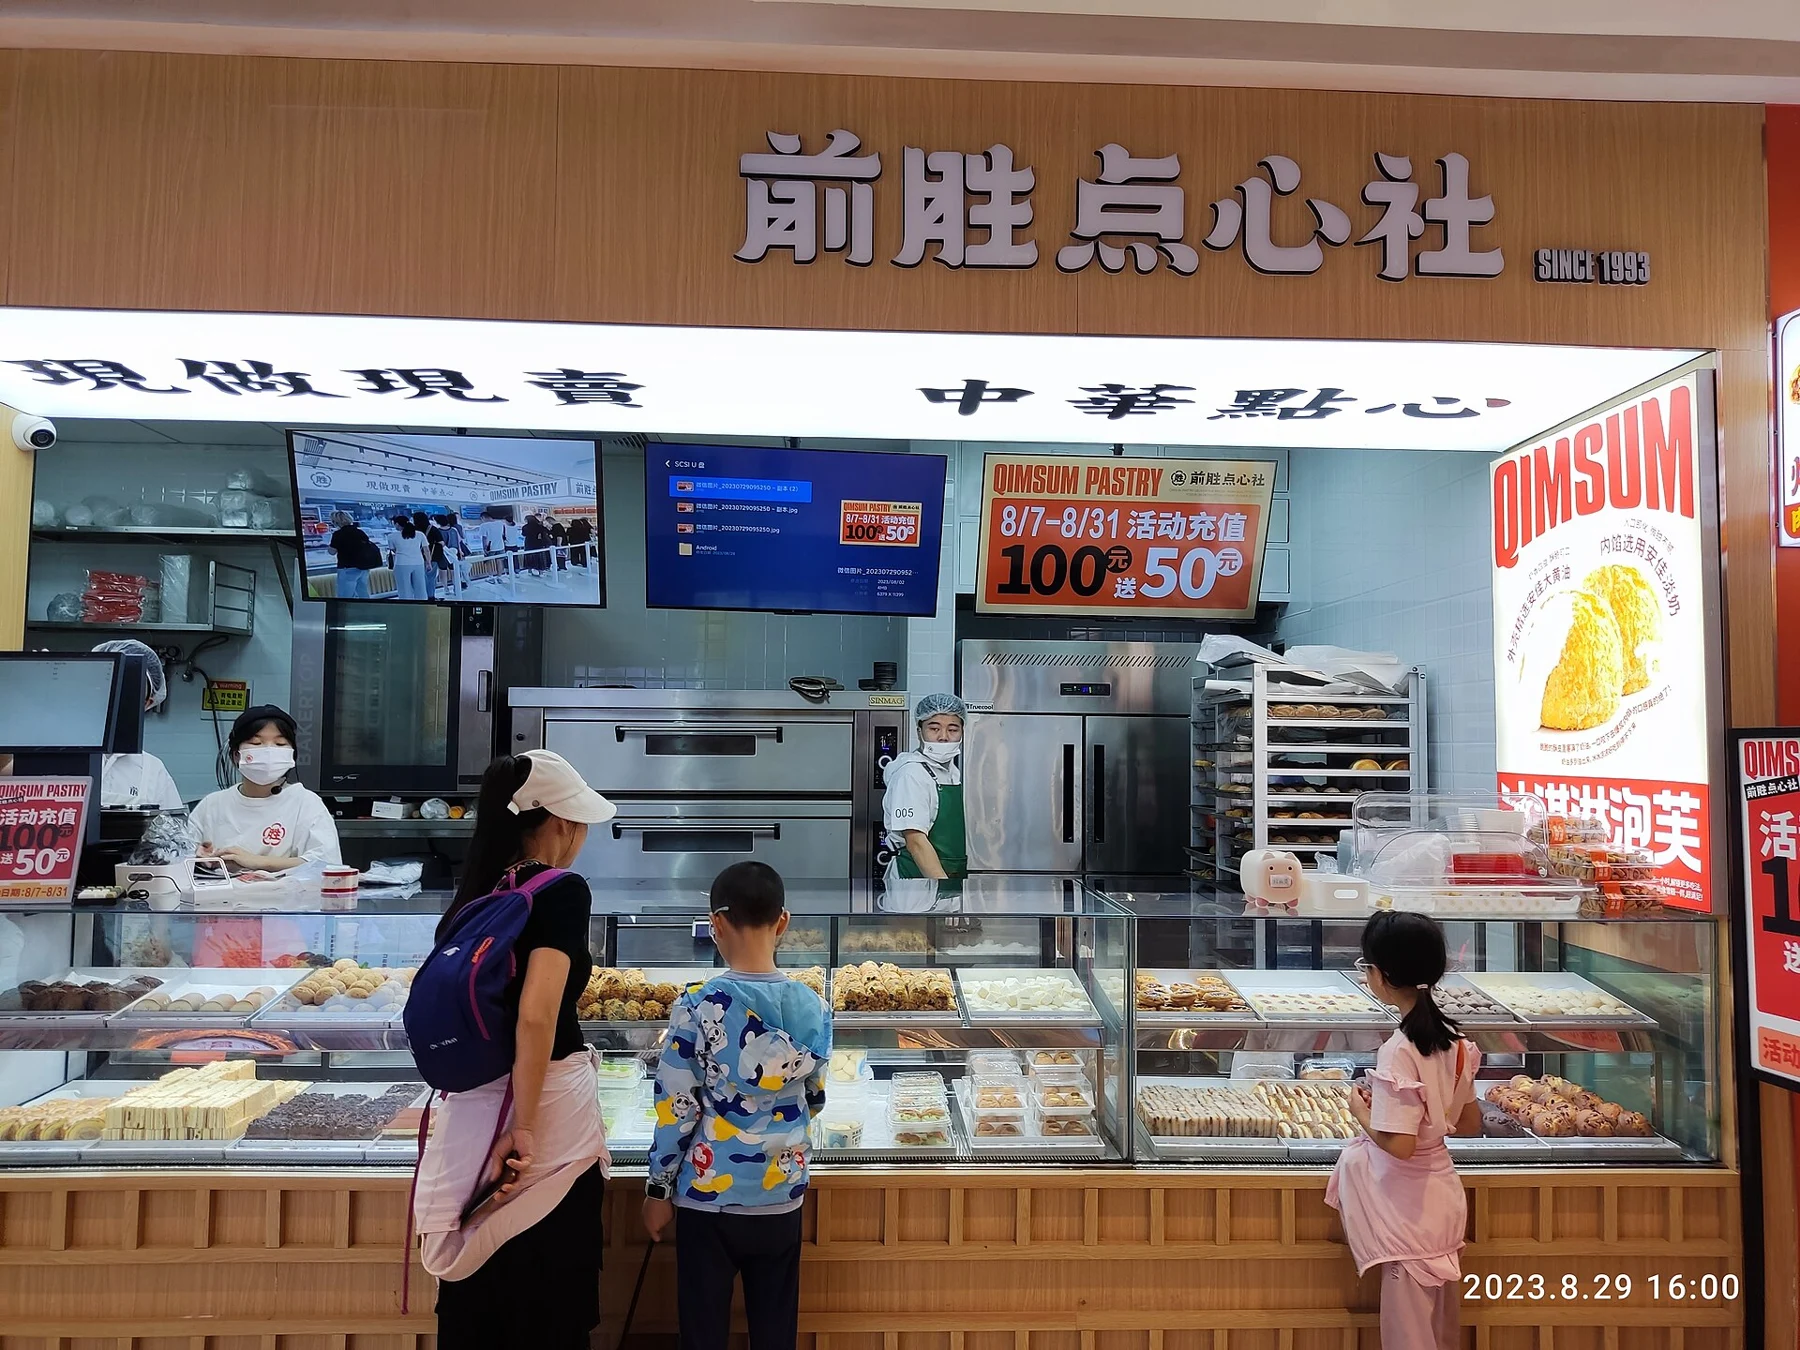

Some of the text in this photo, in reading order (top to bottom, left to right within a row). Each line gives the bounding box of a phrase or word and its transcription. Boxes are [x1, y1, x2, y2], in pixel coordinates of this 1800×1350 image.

[733, 128, 1505, 283] 前胜点心社
[1534, 249, 1651, 285] SINCE 1993
[2, 358, 1511, 420] 現做現賣 中華點心
[674, 460, 690, 468] SCSI
[993, 463, 1164, 497] QIMSUM PASTRY
[1190, 470, 1265, 486] 前胜点心社
[1494, 385, 1694, 568] QIMSUM
[490, 482, 558, 501] QIMSUM PASTRY
[846, 513, 880, 524] 8/7-8/31
[999, 505, 1248, 542] 8/7-8/31 活动充值
[1114, 577, 1137, 599] 送
[298, 652, 315, 767] BAKERTOP
[870, 697, 904, 705] SINMAG
[47, 784, 87, 798] PASTRY
[1746, 779, 1799, 799] 前胜点心社
[0, 808, 77, 826] 活动充值
[895, 808, 914, 818] 005
[1759, 809, 1800, 860] 活
[1, 852, 13, 865] 送
[0, 886, 68, 898] 日期:8/7-8/31
